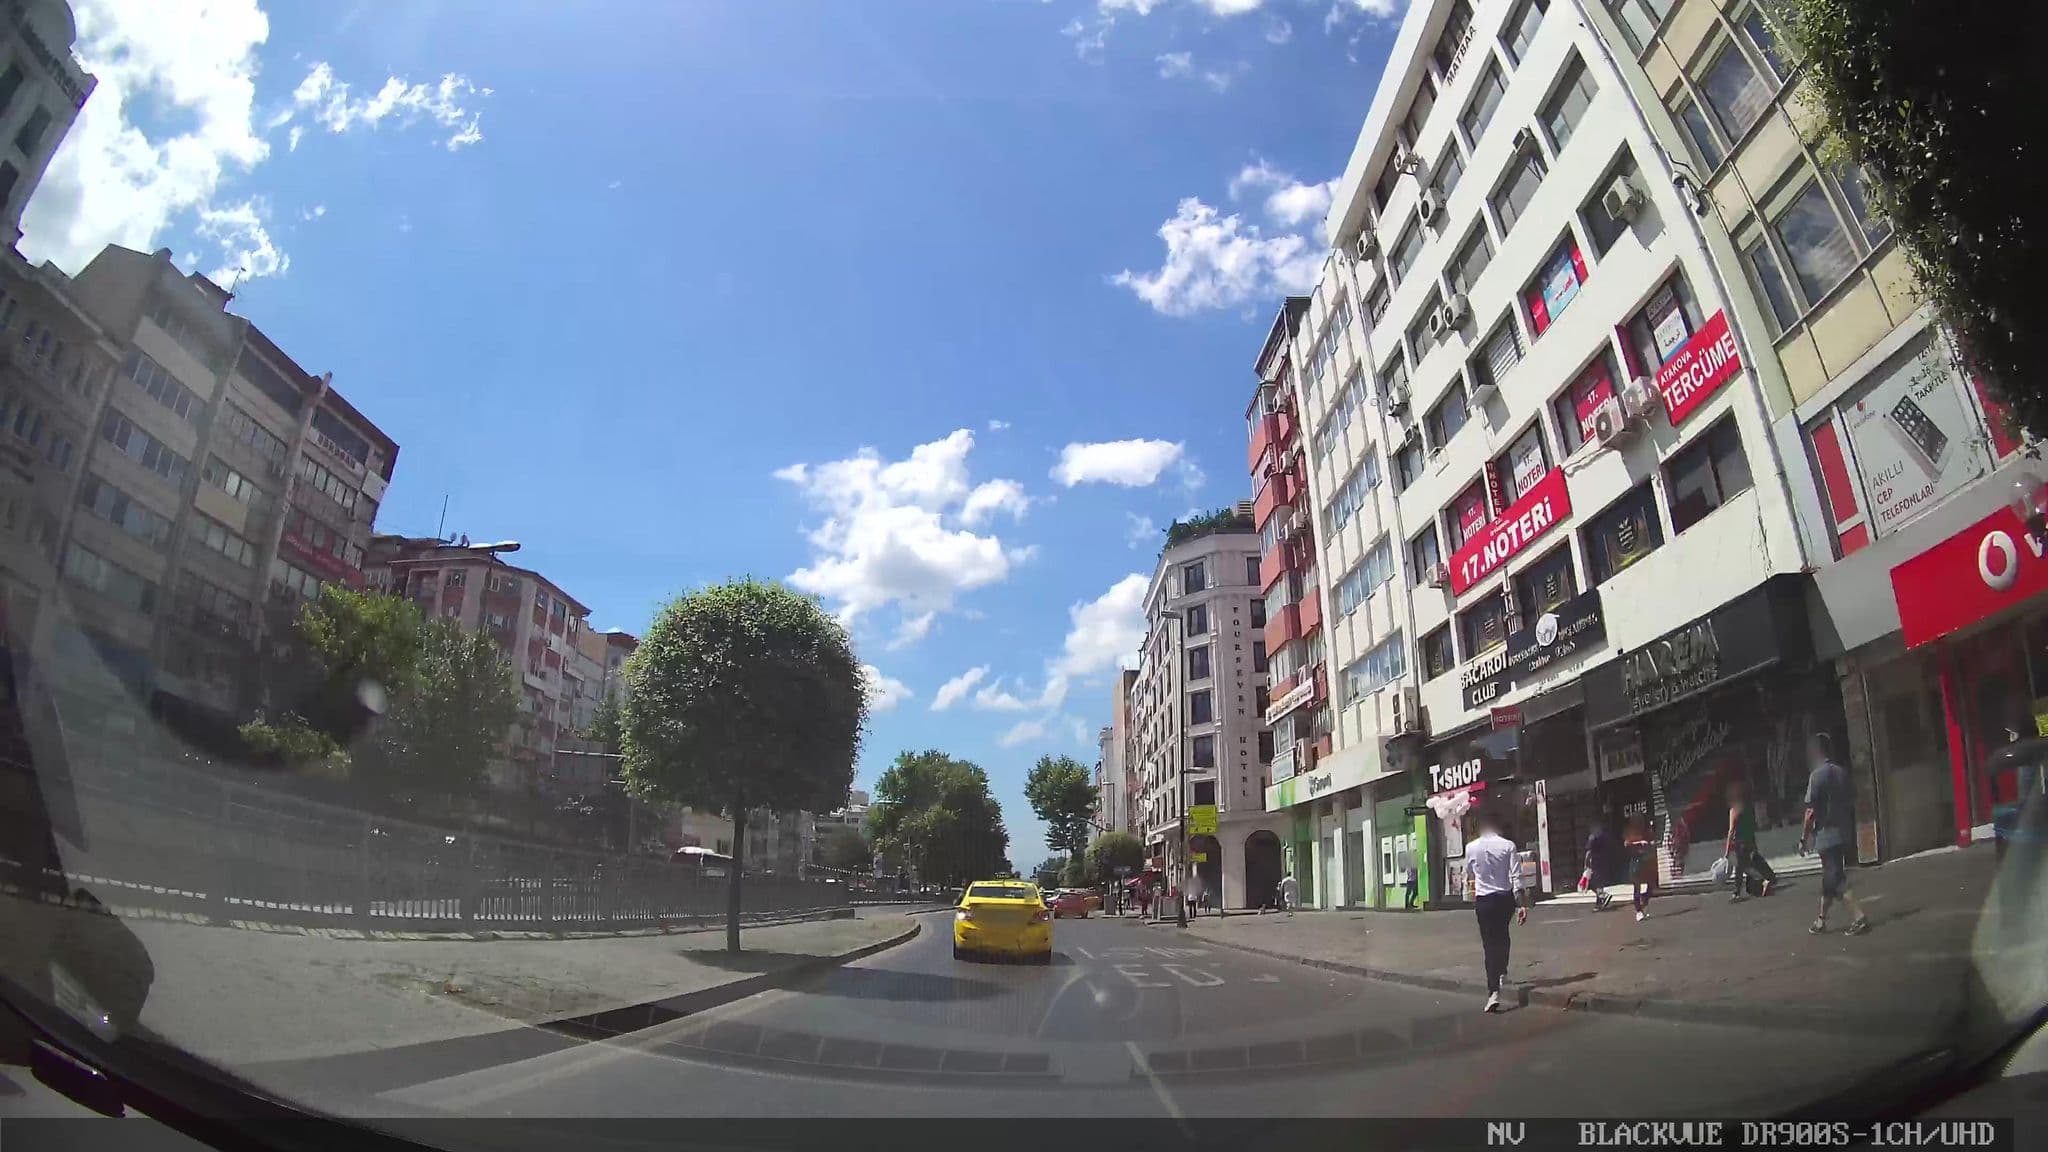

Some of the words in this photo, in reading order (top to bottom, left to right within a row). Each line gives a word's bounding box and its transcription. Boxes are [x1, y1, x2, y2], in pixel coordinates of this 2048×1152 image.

[1446, 26, 1476, 87] MATBAA
[1660, 350, 1692, 386] ATAKOVA
[1663, 332, 1737, 412] TERCÜME
[1872, 461, 1904, 489] AKILLI
[1876, 488, 1894, 505] CEP
[1880, 484, 1935, 523] TELEFONLARI
[1459, 652, 1507, 691] BACARDI
[1472, 681, 1498, 705] CLUB
